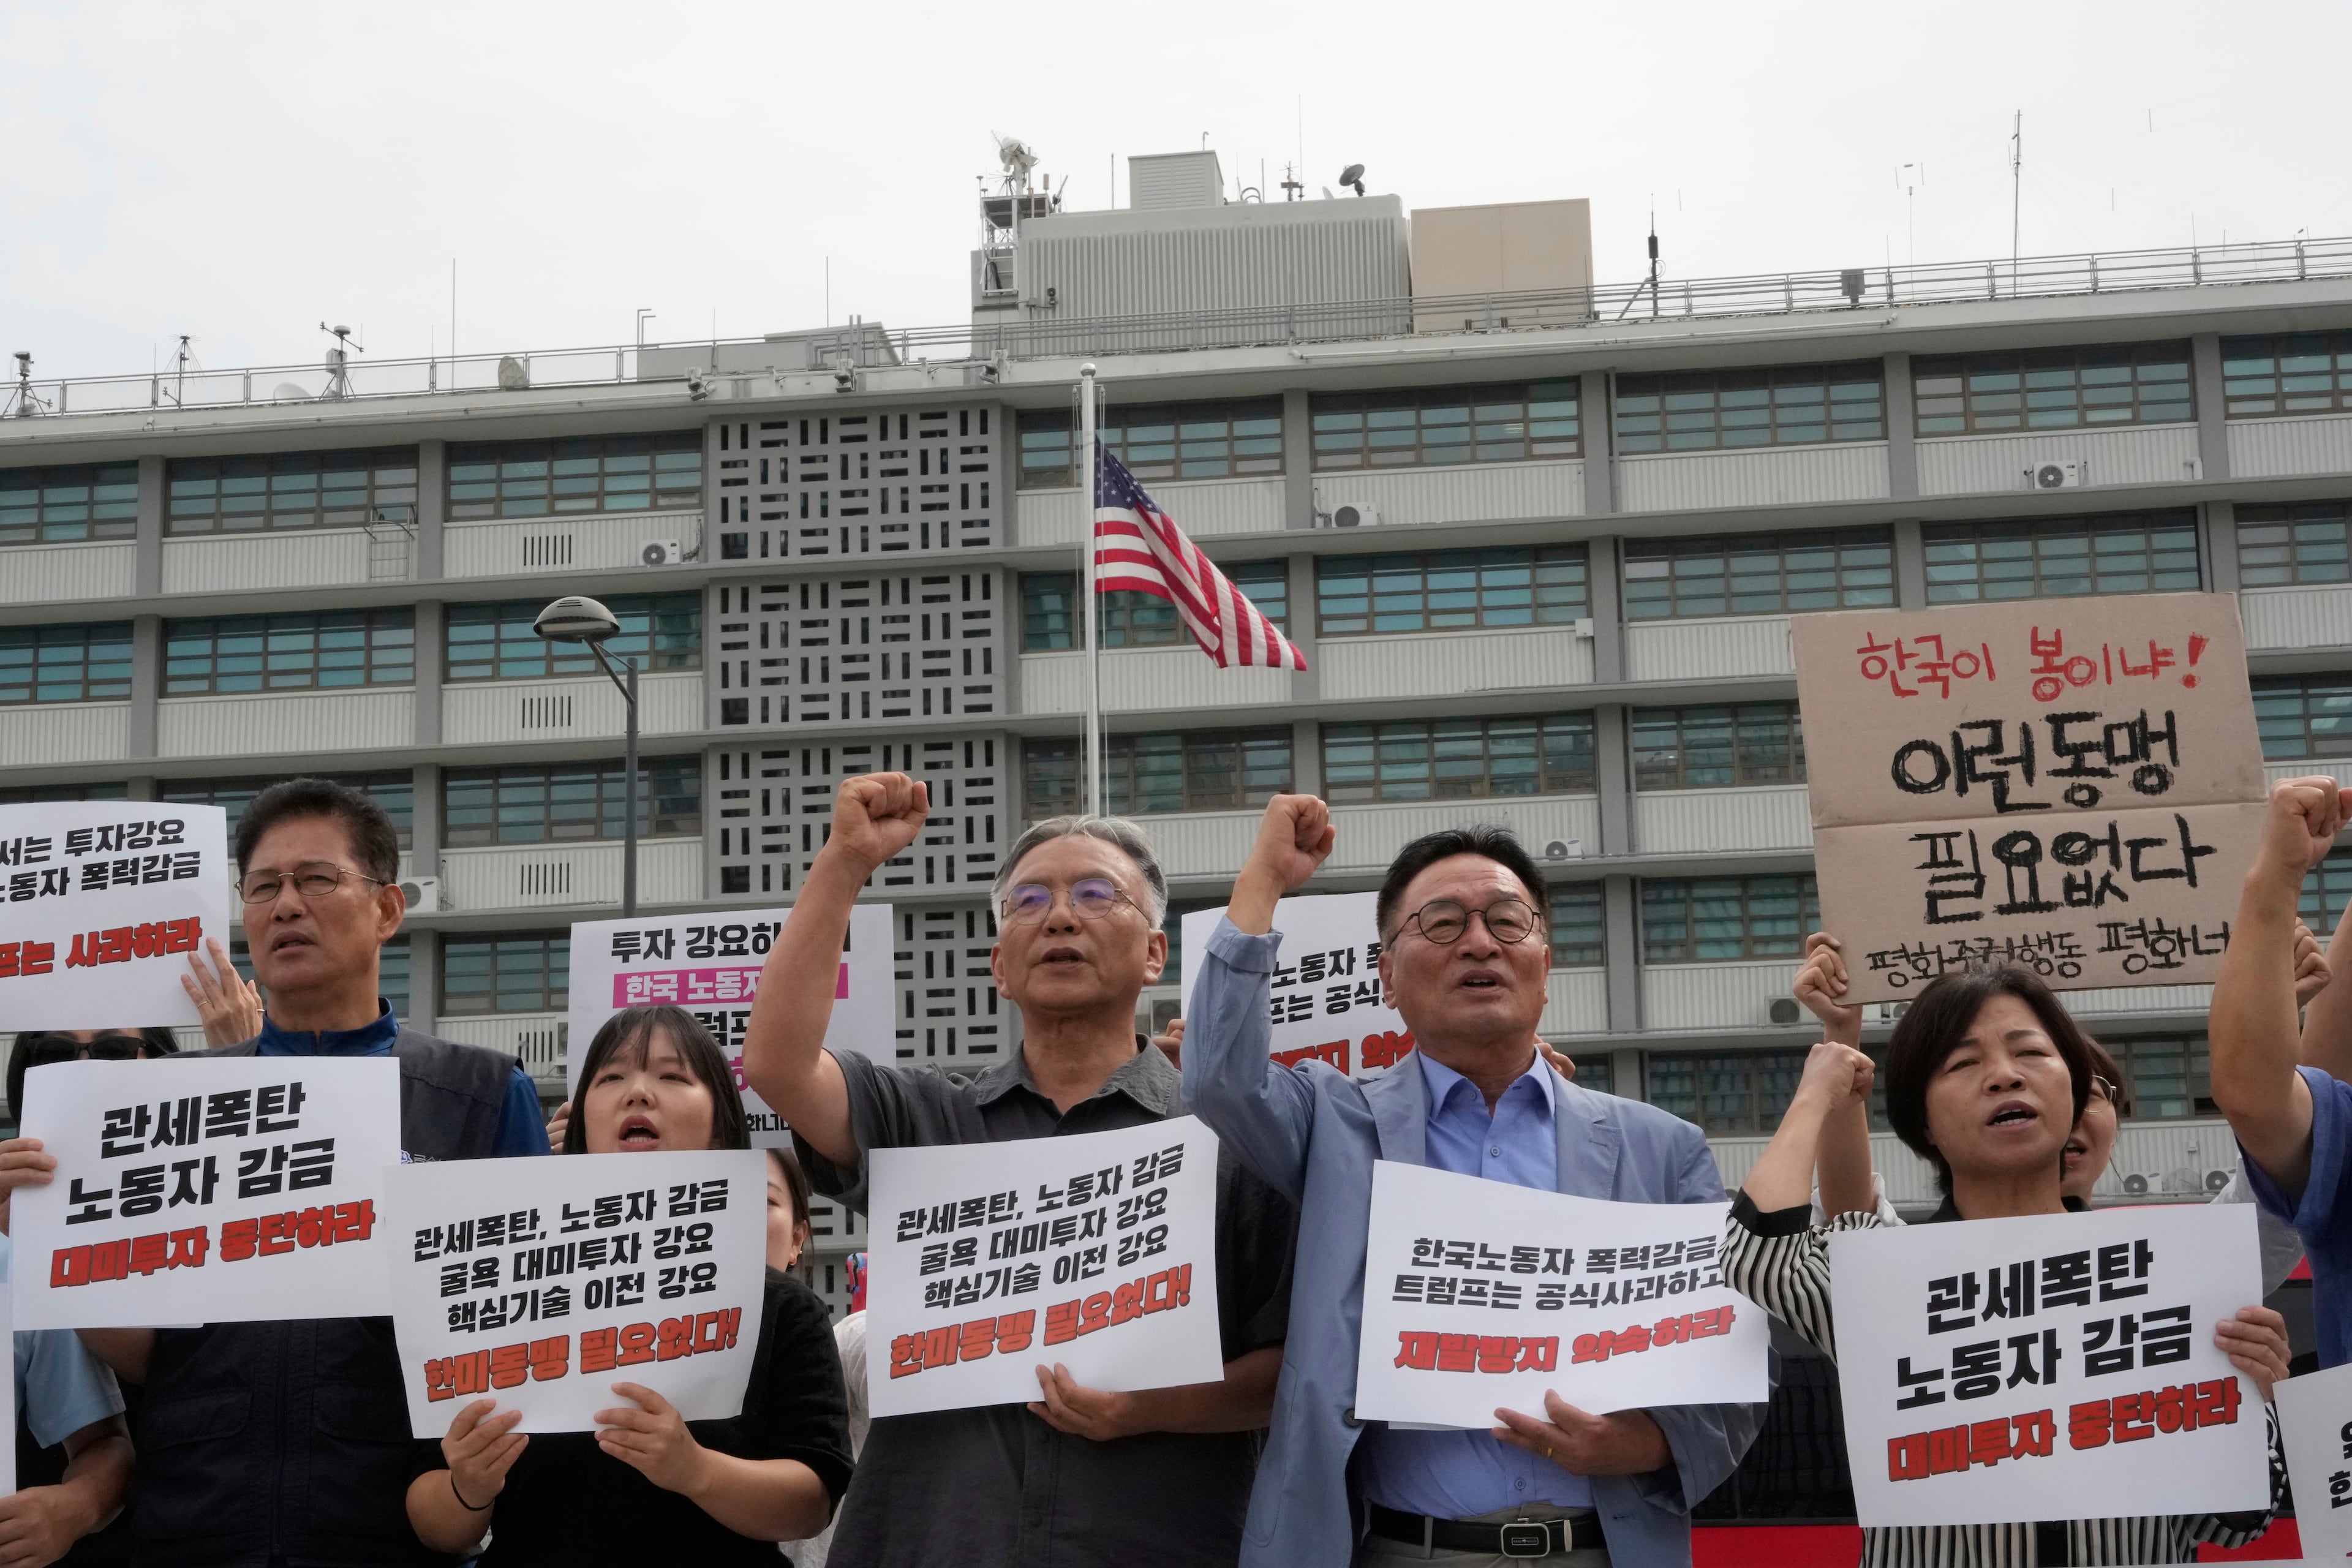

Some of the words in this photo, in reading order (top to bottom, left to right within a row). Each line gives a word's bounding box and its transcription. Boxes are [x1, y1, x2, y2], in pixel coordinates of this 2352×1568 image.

[1857, 631, 1996, 699] 한국이
[2030, 626, 2209, 702] 봉이냐!
[64, 819, 185, 857] 투자강요
[1909, 814, 2216, 925] 필요없다
[0, 867, 70, 903] 동자
[81, 851, 200, 891] 폭력감금
[65, 916, 202, 968] 사과하라
[611, 929, 676, 963] 투자
[626, 973, 679, 1004] 한국
[1325, 978, 1385, 1015] 공식
[101, 1082, 306, 1159] 관세폭탄
[66, 1156, 219, 1225] 노동자
[238, 1138, 335, 1199] 감금
[897, 1189, 1023, 1243] 관세폭탄,
[1036, 1164, 1123, 1215] 노동자
[1131, 1143, 1185, 1188] 감금
[50, 1226, 209, 1288] 대미투자
[220, 1199, 375, 1262] 중단하라
[414, 1208, 546, 1262] 관세폭탄,
[560, 1189, 657, 1234] 노동자
[668, 1179, 729, 1217] 감금
[919, 1239, 978, 1276] 굴욕
[989, 1207, 1107, 1261] 대미투자
[1117, 1187, 1168, 1230] 강요
[1411, 1237, 1575, 1275] 한국노동자
[1586, 1235, 1717, 1275] 폭력감금
[440, 1256, 500, 1297] 굴욕
[513, 1233, 641, 1283] 대미투자
[653, 1222, 714, 1261] 강요
[448, 1286, 571, 1333] 핵심기술
[584, 1272, 645, 1310] 이전
[658, 1262, 717, 1300] 강요
[924, 1262, 1041, 1308] 핵심기술
[1052, 1244, 1107, 1284] 이전
[1117, 1224, 1169, 1267] 강요
[1392, 1274, 1522, 1310] 트럼프는
[1536, 1264, 1725, 1311] 공식사과하고
[1926, 1238, 2153, 1335] 관세폭탄
[424, 1333, 570, 1403] 한미동맹
[580, 1306, 742, 1374] 필요없다!
[890, 1309, 1036, 1379] 한미동맹
[1043, 1263, 1192, 1346] 필요없다!
[1393, 1330, 1559, 1374] 재발방지
[1571, 1305, 1736, 1365] 약속하라
[1896, 1329, 2062, 1411] 노동자
[2082, 1305, 2192, 1378] 감금
[1887, 1409, 2057, 1482] 대미투자
[2068, 1376, 2242, 1450] 중단하라
